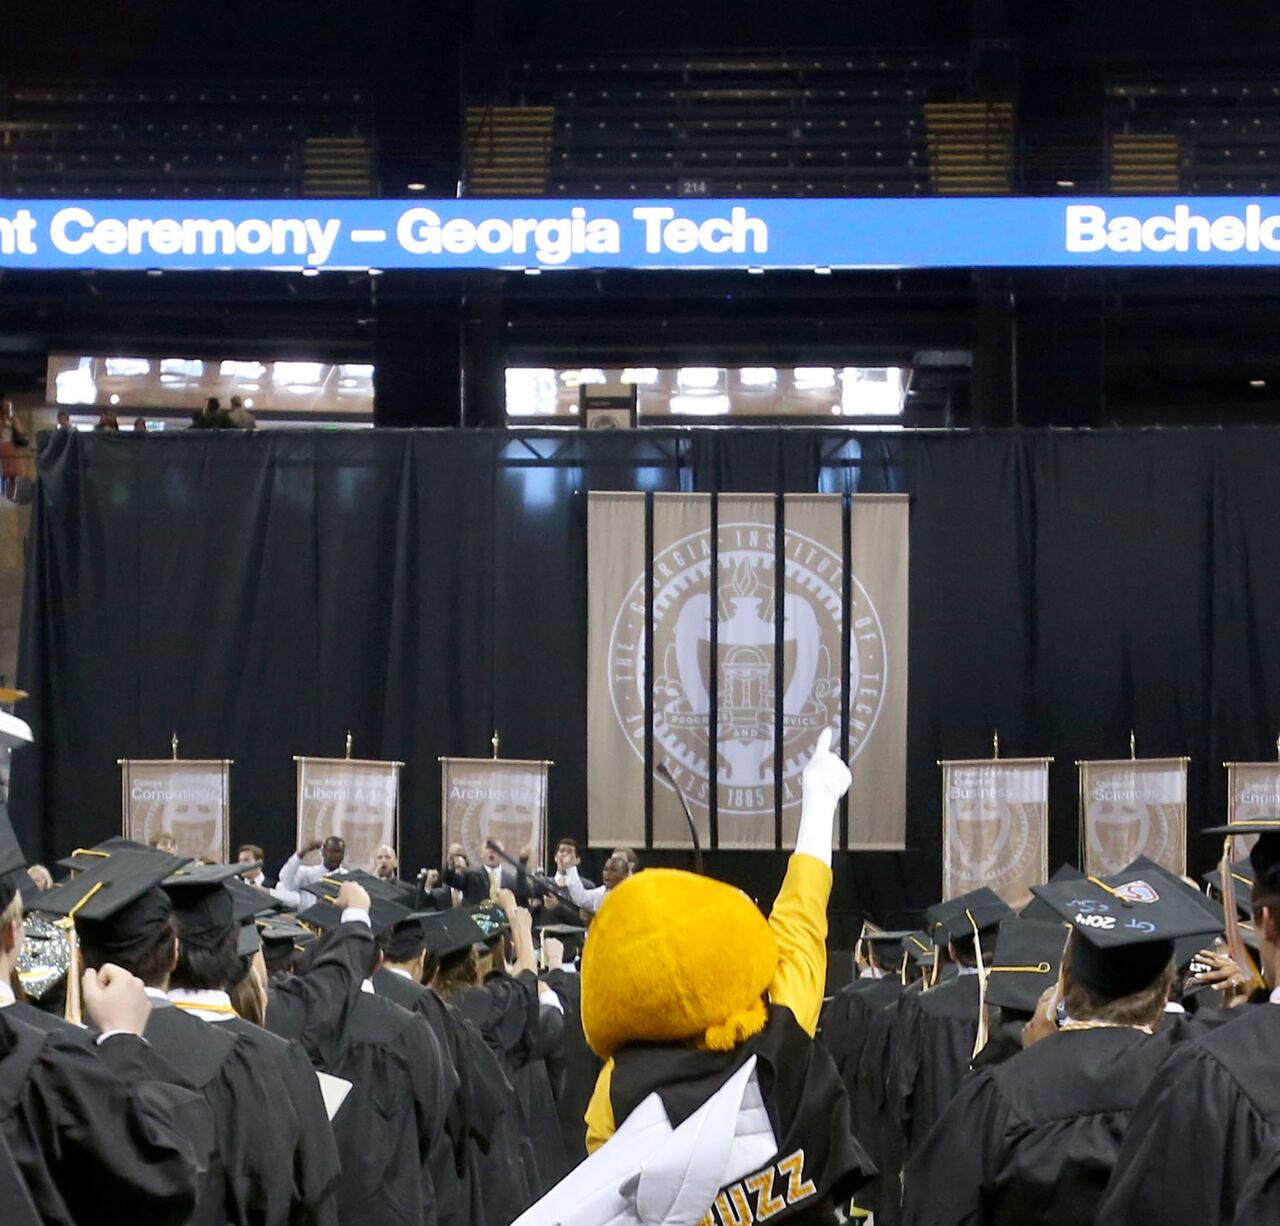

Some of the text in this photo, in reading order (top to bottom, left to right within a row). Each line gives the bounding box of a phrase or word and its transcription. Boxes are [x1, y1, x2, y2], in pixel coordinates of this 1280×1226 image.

[683, 181, 705, 193] 214
[49, 207, 342, 266] Ceremony
[396, 206, 621, 265] Georgia
[632, 206, 769, 254] Tech
[736, 529, 843, 595] INSTITUT
[728, 787, 765, 809] 1885
[1074, 912, 1117, 930] 2014
